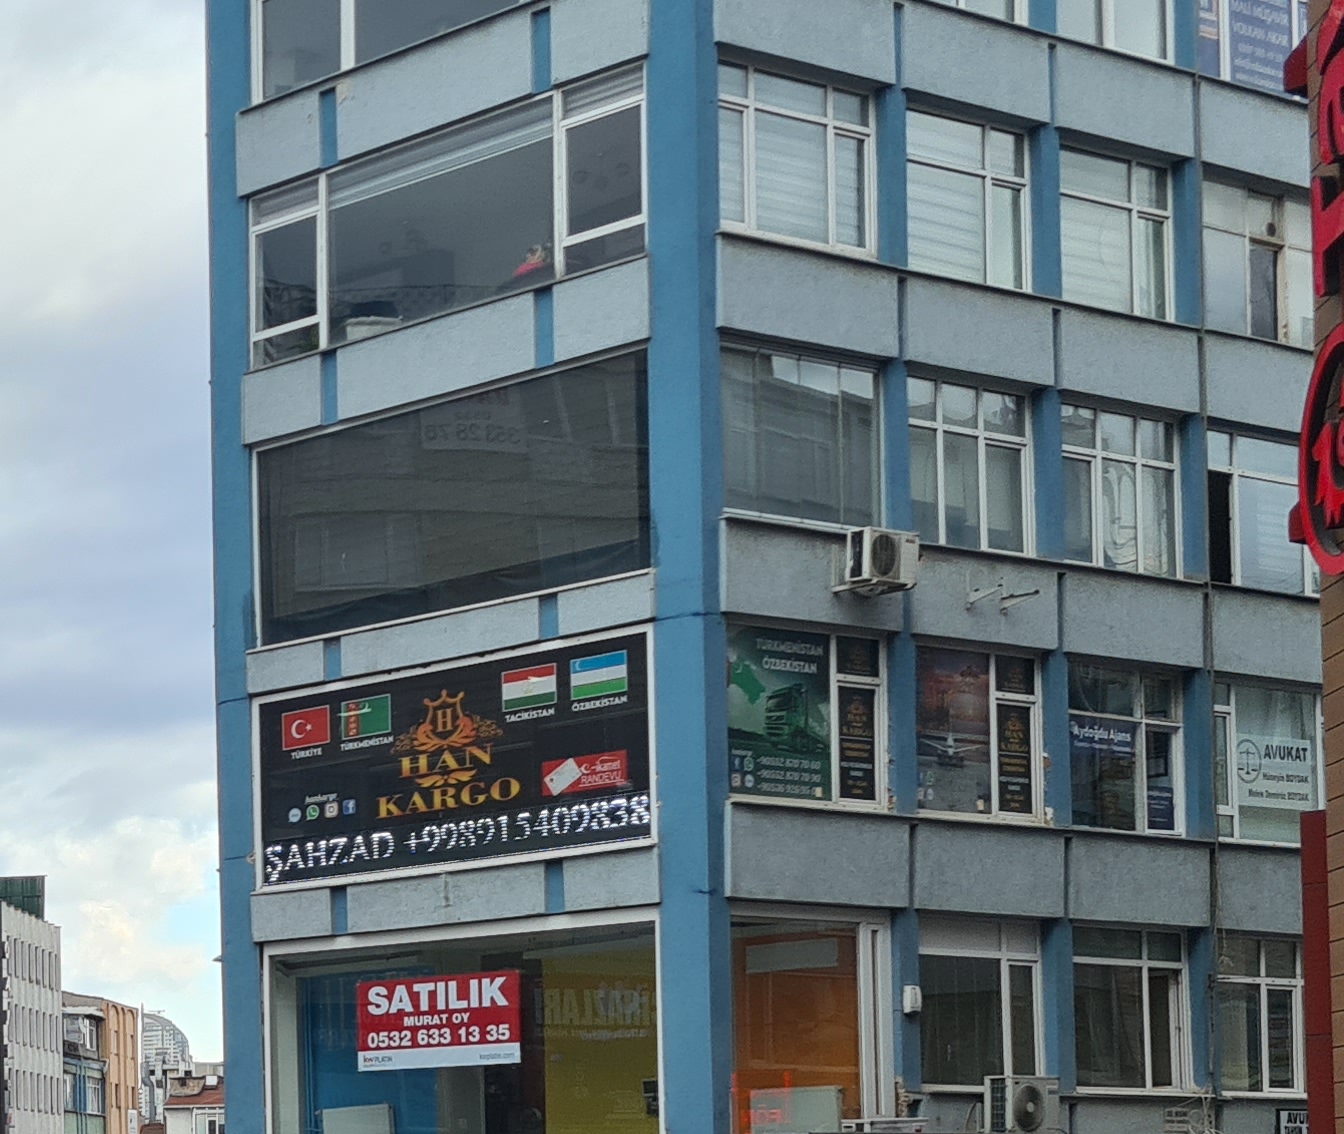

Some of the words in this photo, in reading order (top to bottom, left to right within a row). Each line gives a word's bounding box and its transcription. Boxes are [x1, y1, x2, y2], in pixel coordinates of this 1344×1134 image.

[400, 742, 493, 778] HAN
[1263, 744, 1308, 762] AVUKAT
[376, 777, 521, 819] KARGO
[367, 976, 509, 1016] SATILIK
[403, 1014, 449, 1027] MURAT
[452, 1012, 470, 1024] OY
[367, 1031, 412, 1049] 0532
[417, 1027, 452, 1046] 633
[458, 1026, 480, 1043] 13
[486, 1024, 510, 1041] 35
[1287, 1112, 1309, 1124] AVU
